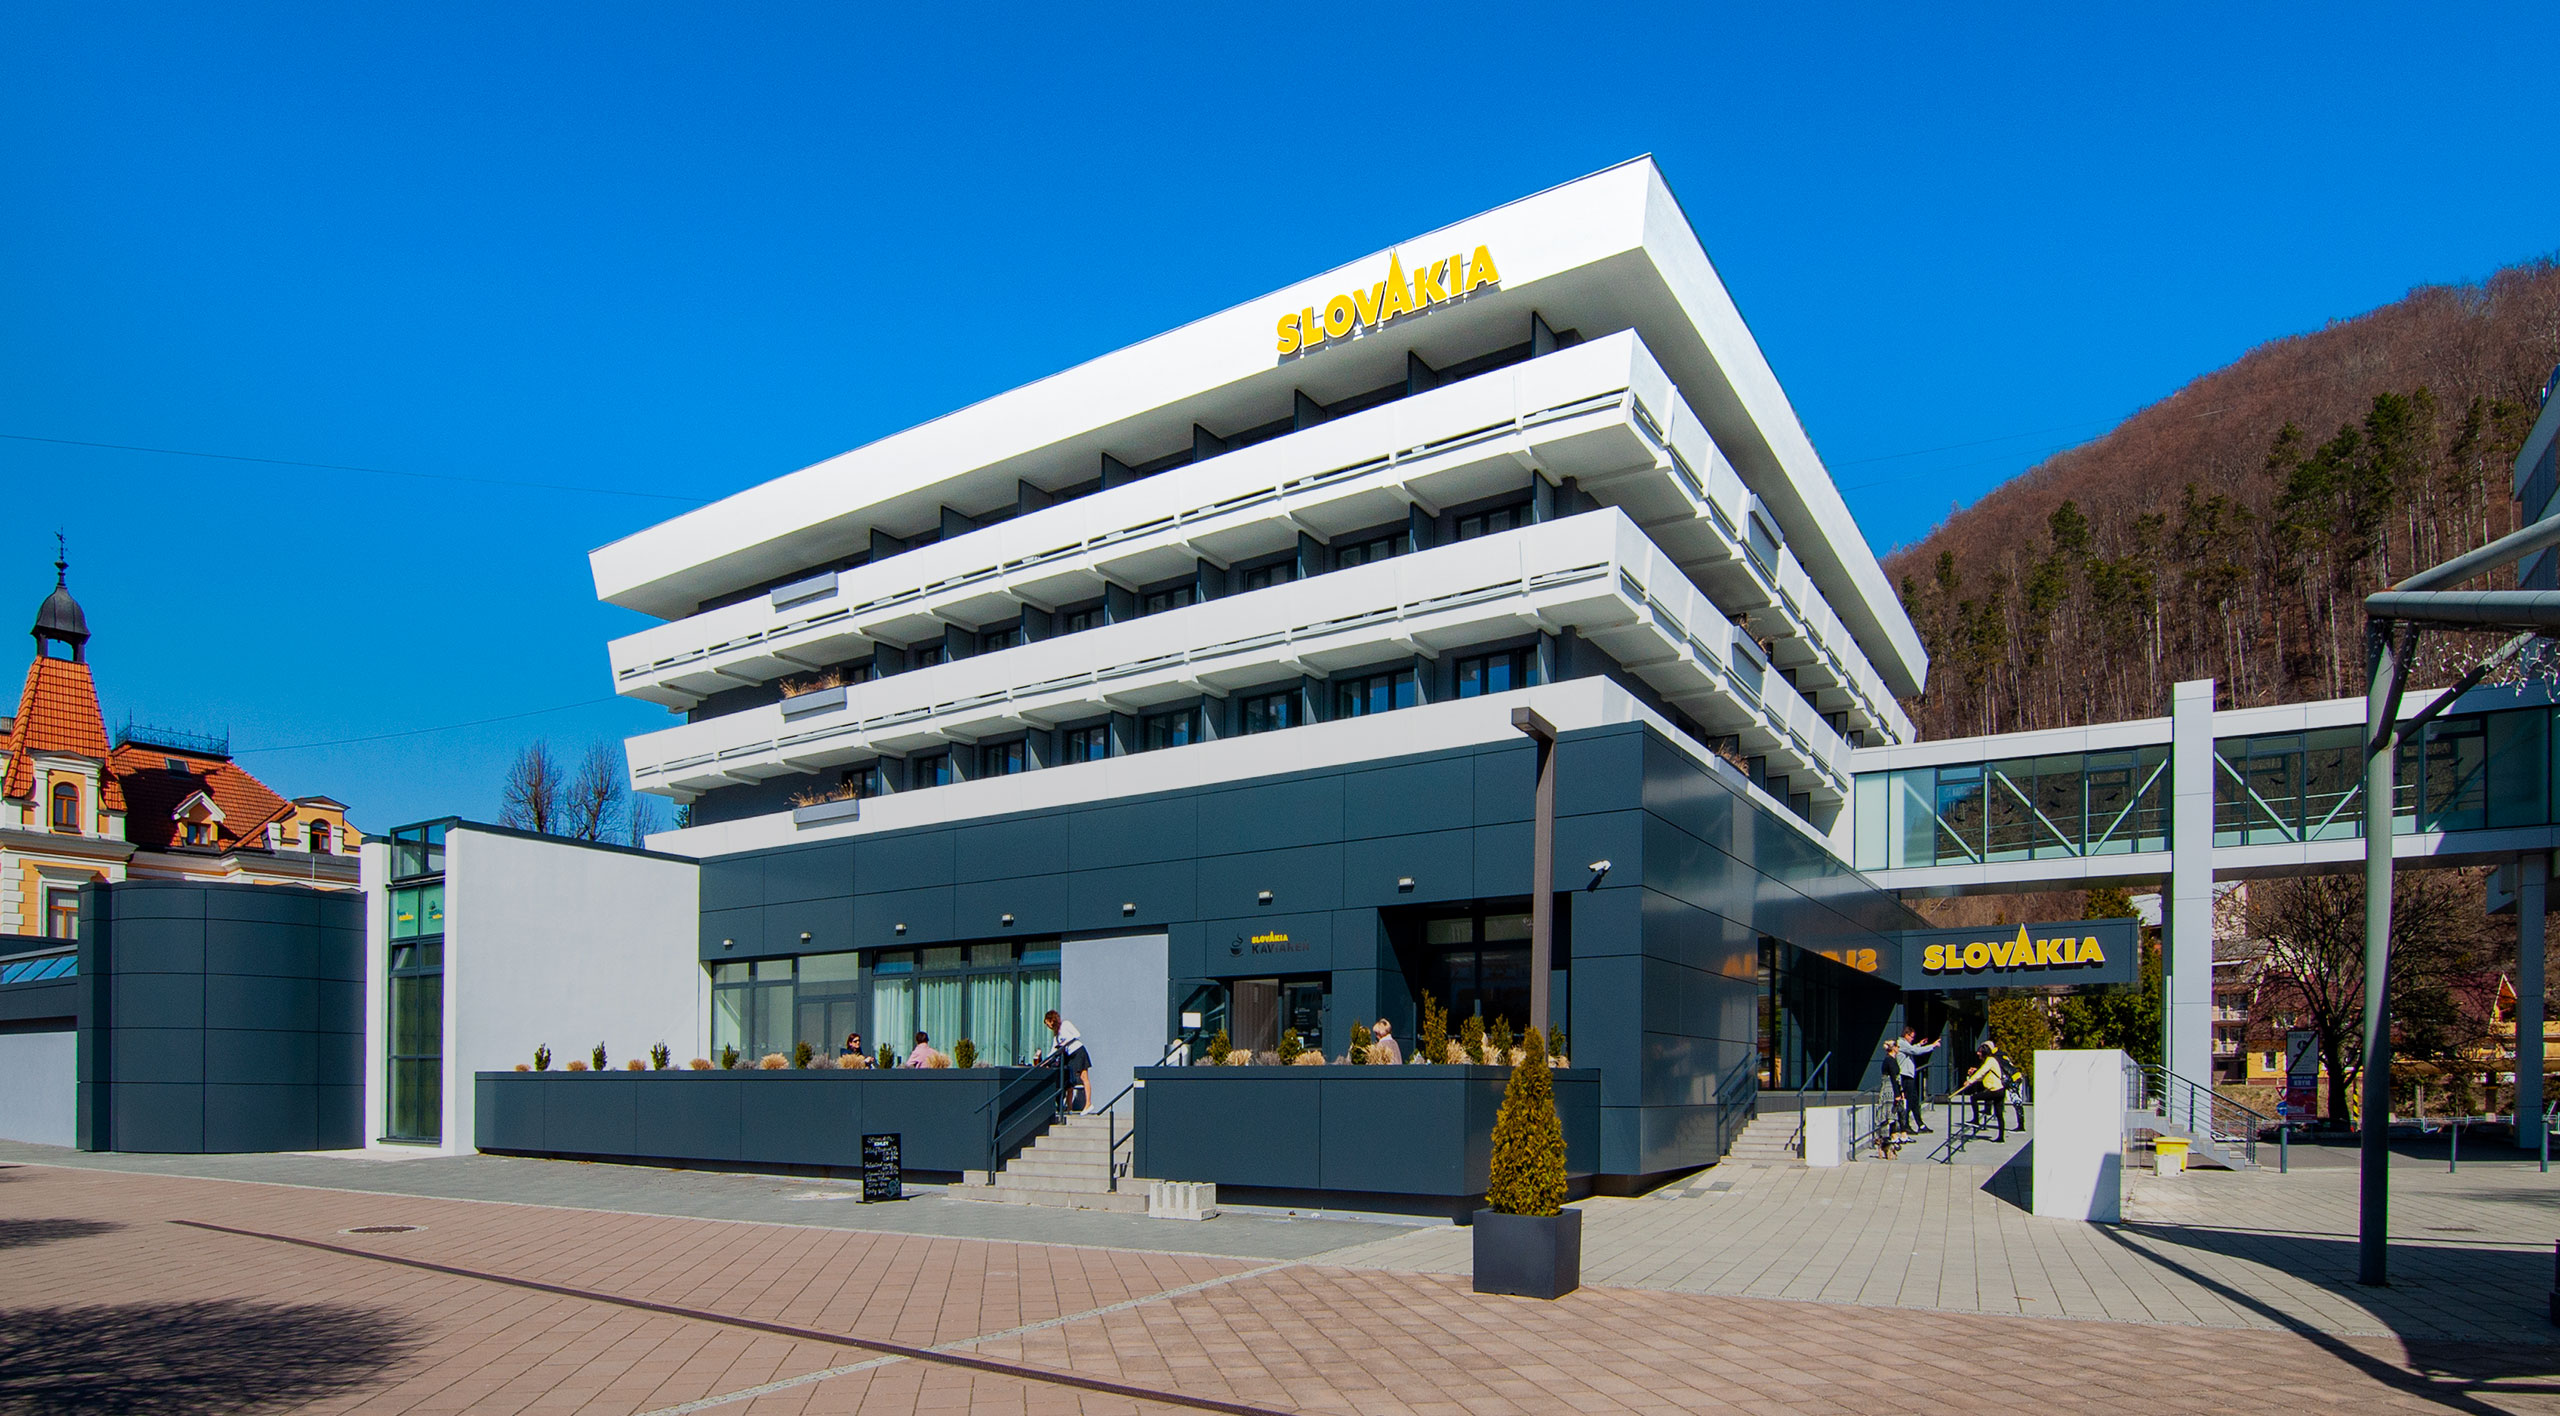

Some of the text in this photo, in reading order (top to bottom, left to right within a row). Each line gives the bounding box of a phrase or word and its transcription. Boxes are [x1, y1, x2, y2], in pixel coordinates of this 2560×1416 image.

[1277, 244, 1501, 355] SLOVAKIA
[1252, 931, 1288, 944] SLOVAKIA
[1923, 923, 2105, 970] SLOVAKIA
